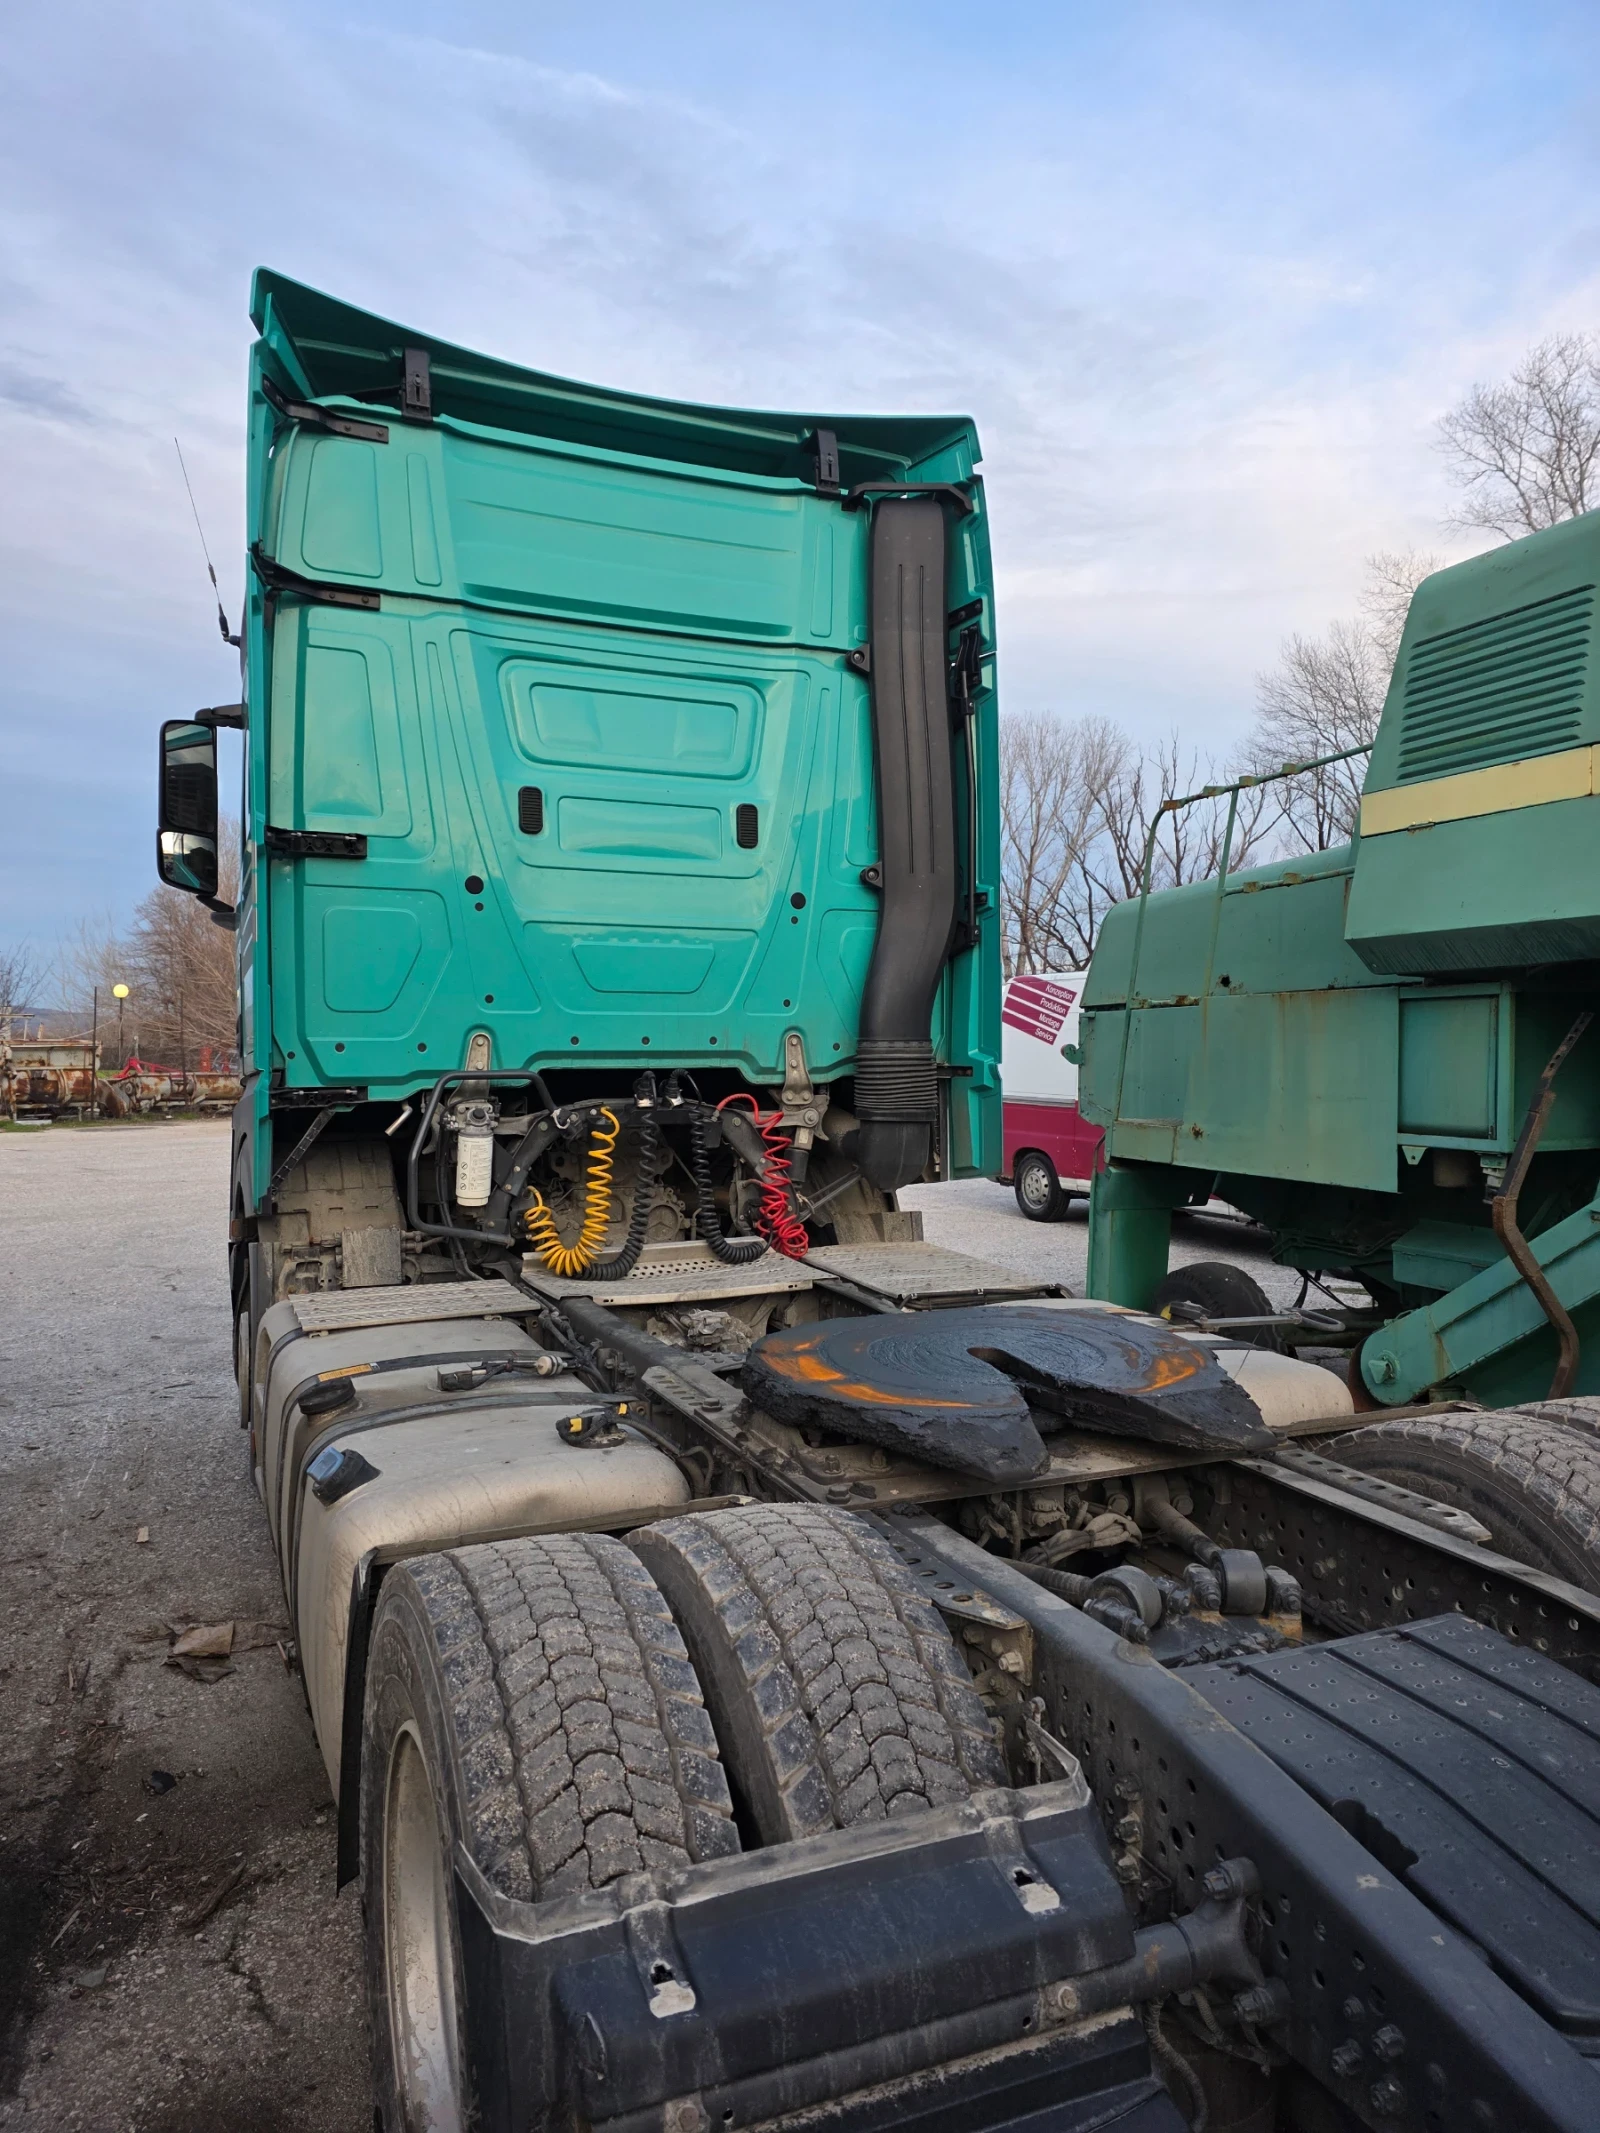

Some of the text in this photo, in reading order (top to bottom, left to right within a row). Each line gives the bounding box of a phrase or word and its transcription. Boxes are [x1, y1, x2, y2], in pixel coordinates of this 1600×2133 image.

[1045, 984, 1073, 1001] Konzeption
[1040, 997, 1066, 1014] Produktion
[1039, 1013, 1060, 1029] Montage
[1035, 1028, 1054, 1042] Service
